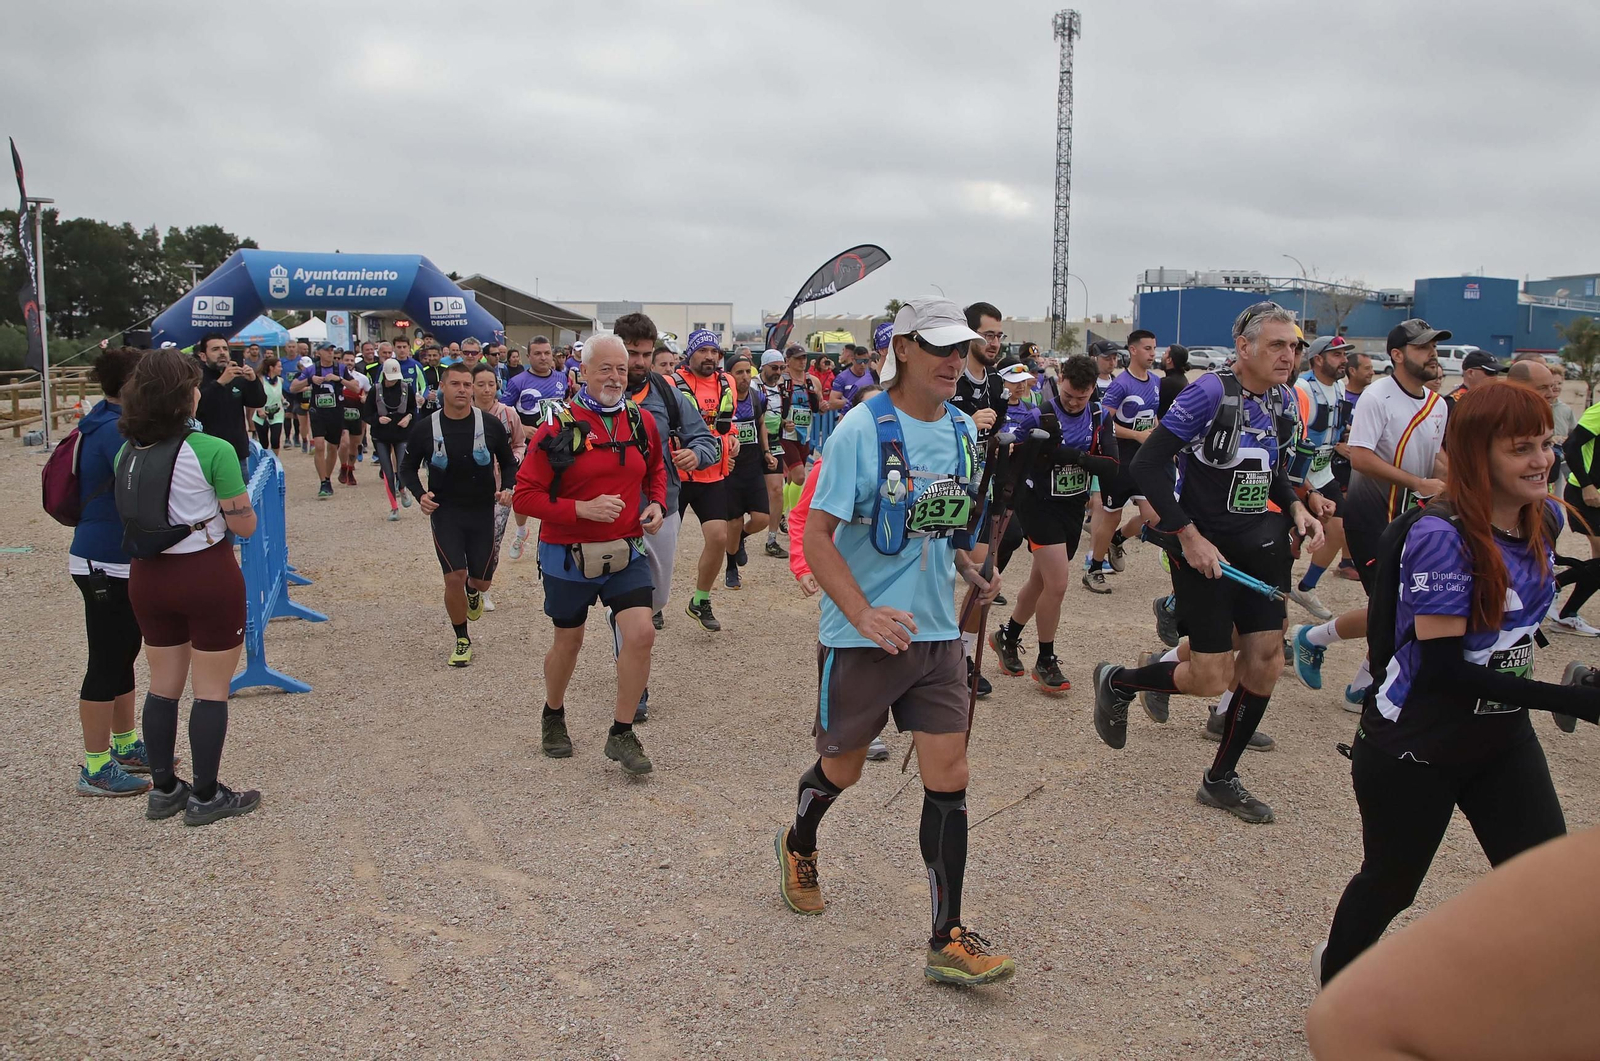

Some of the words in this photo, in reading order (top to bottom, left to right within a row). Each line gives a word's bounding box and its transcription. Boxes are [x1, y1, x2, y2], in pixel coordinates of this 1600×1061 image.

[293, 267, 398, 283] Ayuntamiento
[305, 284, 324, 297] de
[326, 285, 345, 297] La
[347, 284, 387, 297] Línea
[198, 300, 208, 311] D
[434, 301, 444, 312] D
[191, 320, 233, 328] DEPORTES
[431, 319, 468, 327] DEPORTES
[1058, 474, 1085, 488] 418
[917, 489, 967, 502] CARBONERA
[1238, 486, 1268, 501] 225
[916, 499, 965, 523] 337
[1432, 583, 1444, 592] de
